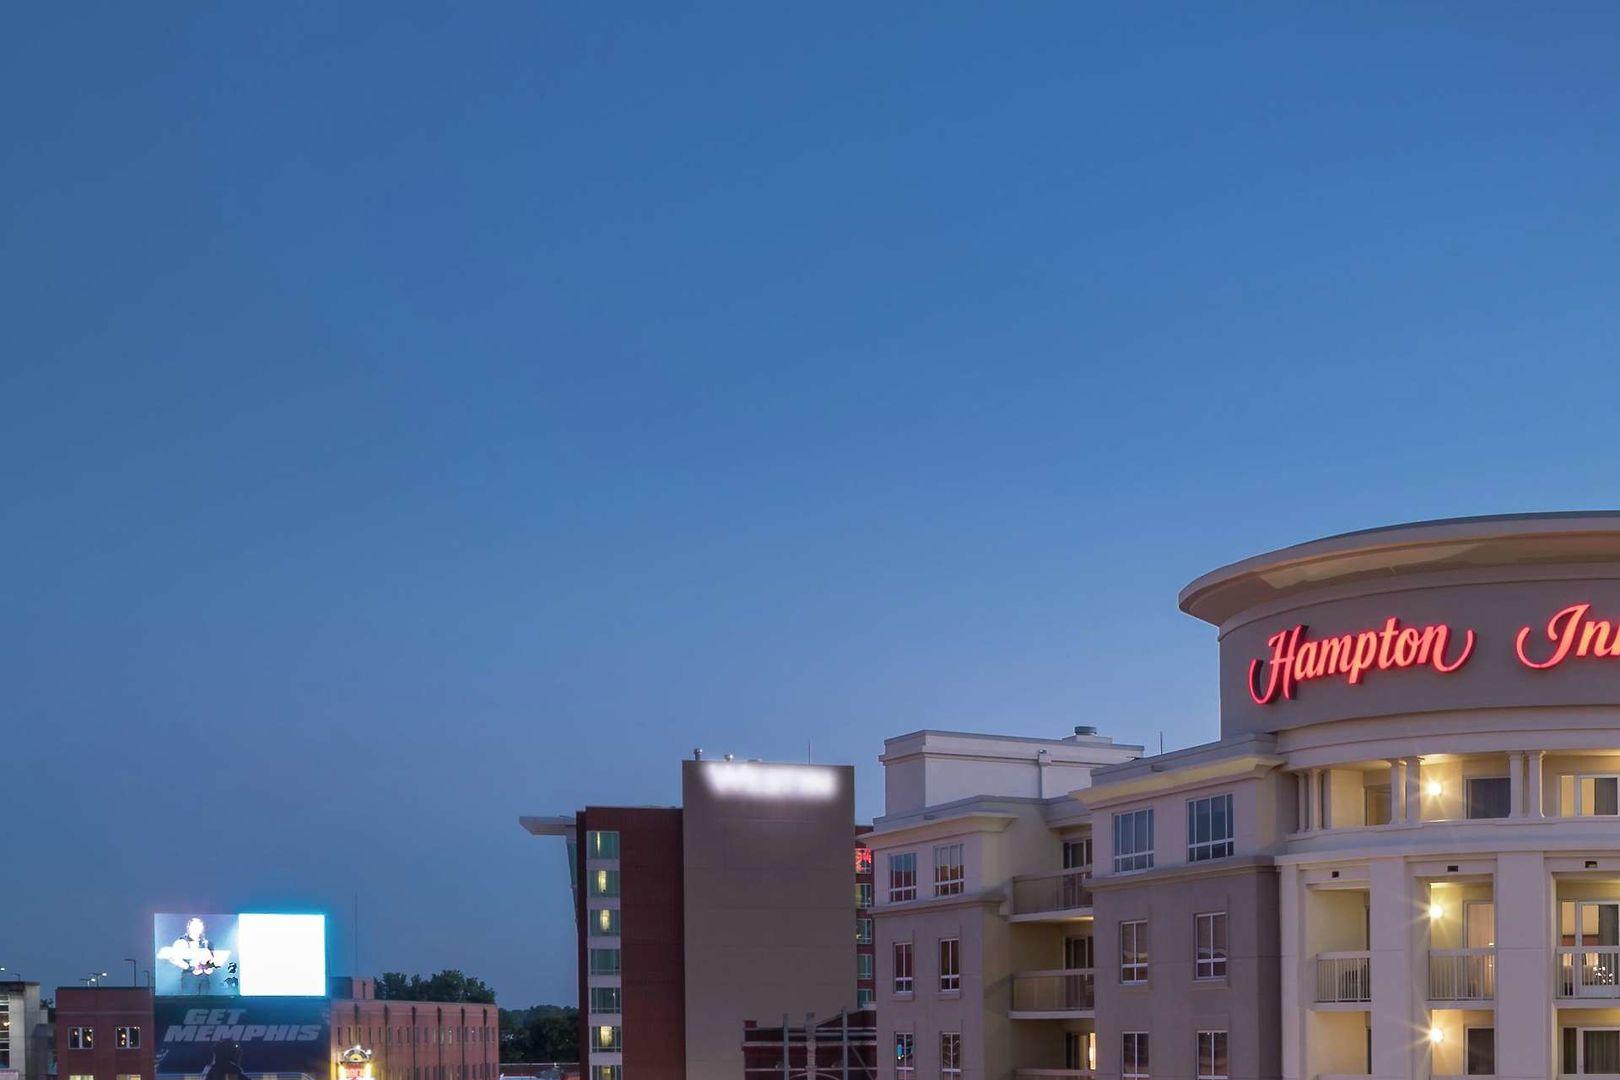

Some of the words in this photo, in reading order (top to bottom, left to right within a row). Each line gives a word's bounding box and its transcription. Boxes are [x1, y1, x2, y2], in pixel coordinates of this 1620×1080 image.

[1249, 617, 1476, 705] Hampton
[184, 1008, 247, 1025] GET
[163, 1024, 322, 1042] MEMPHIS
